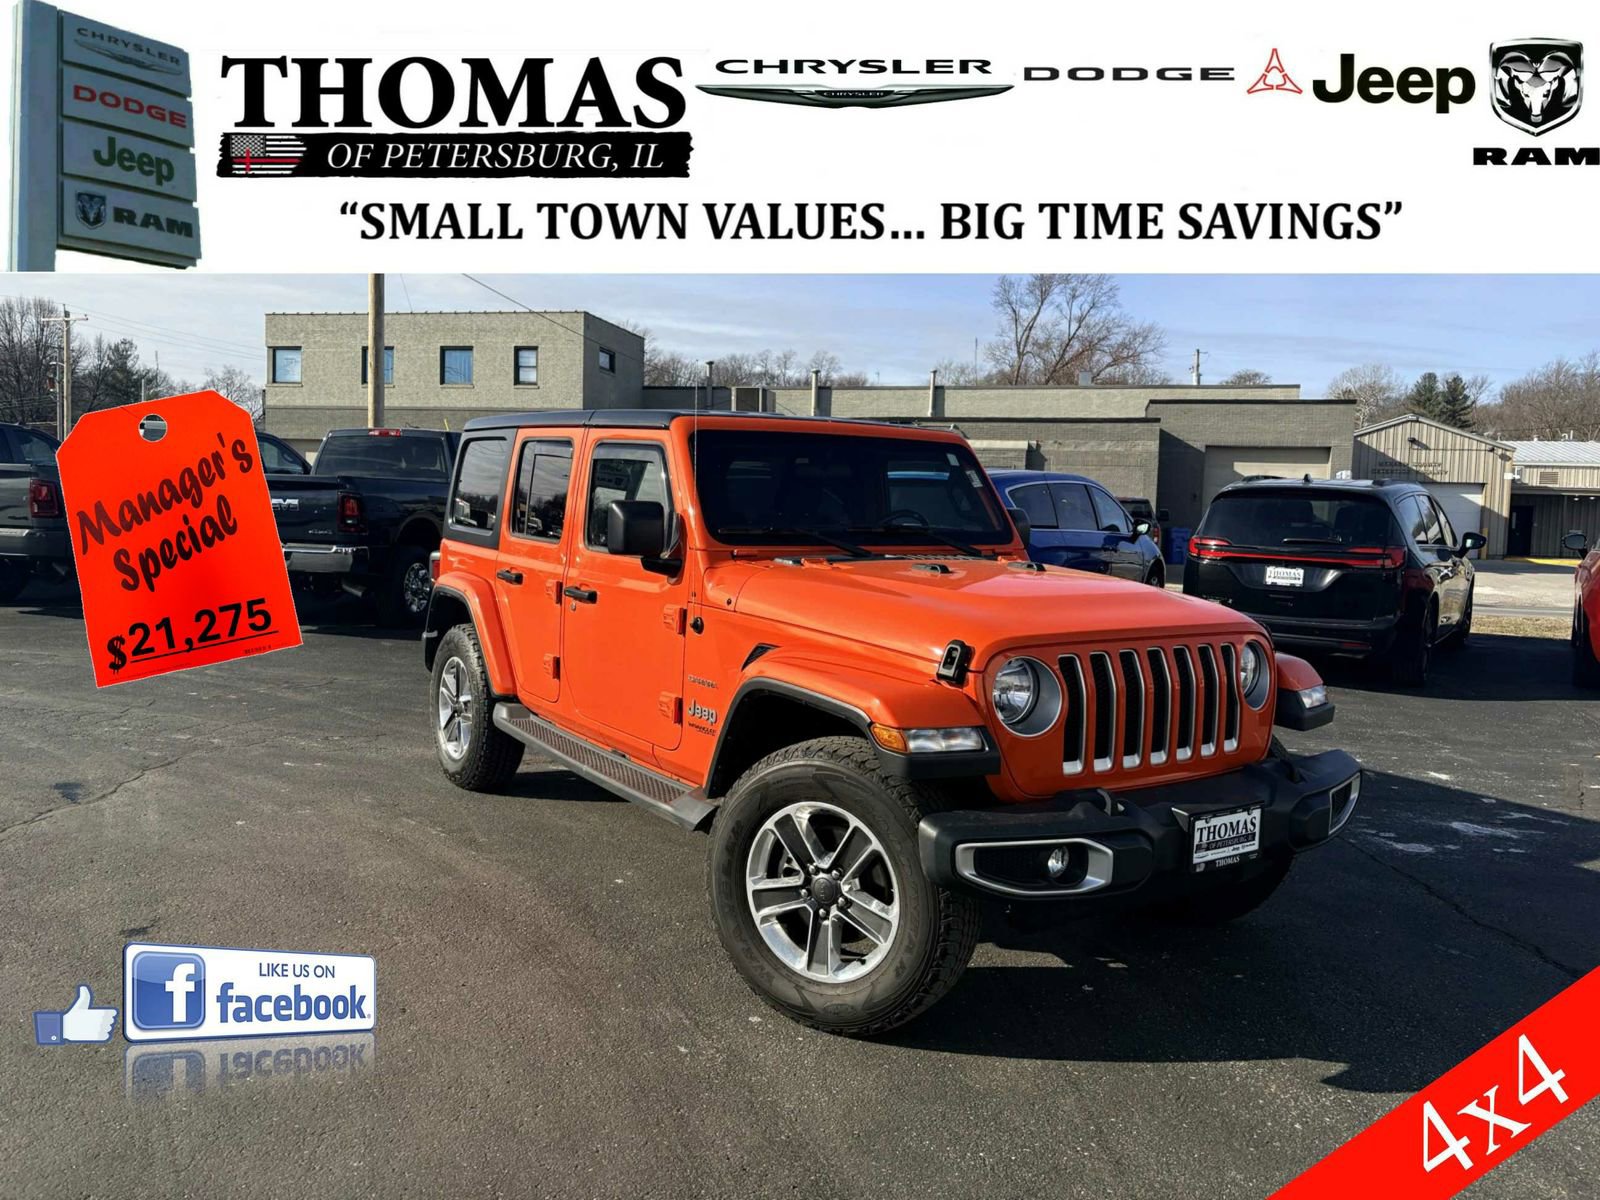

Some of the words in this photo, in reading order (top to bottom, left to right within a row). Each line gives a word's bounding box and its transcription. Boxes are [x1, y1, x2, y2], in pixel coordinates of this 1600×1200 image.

[688, 699, 717, 725] Jeep
[1197, 816, 1257, 843] THOMAS
[1215, 855, 1240, 868] THOMAS
